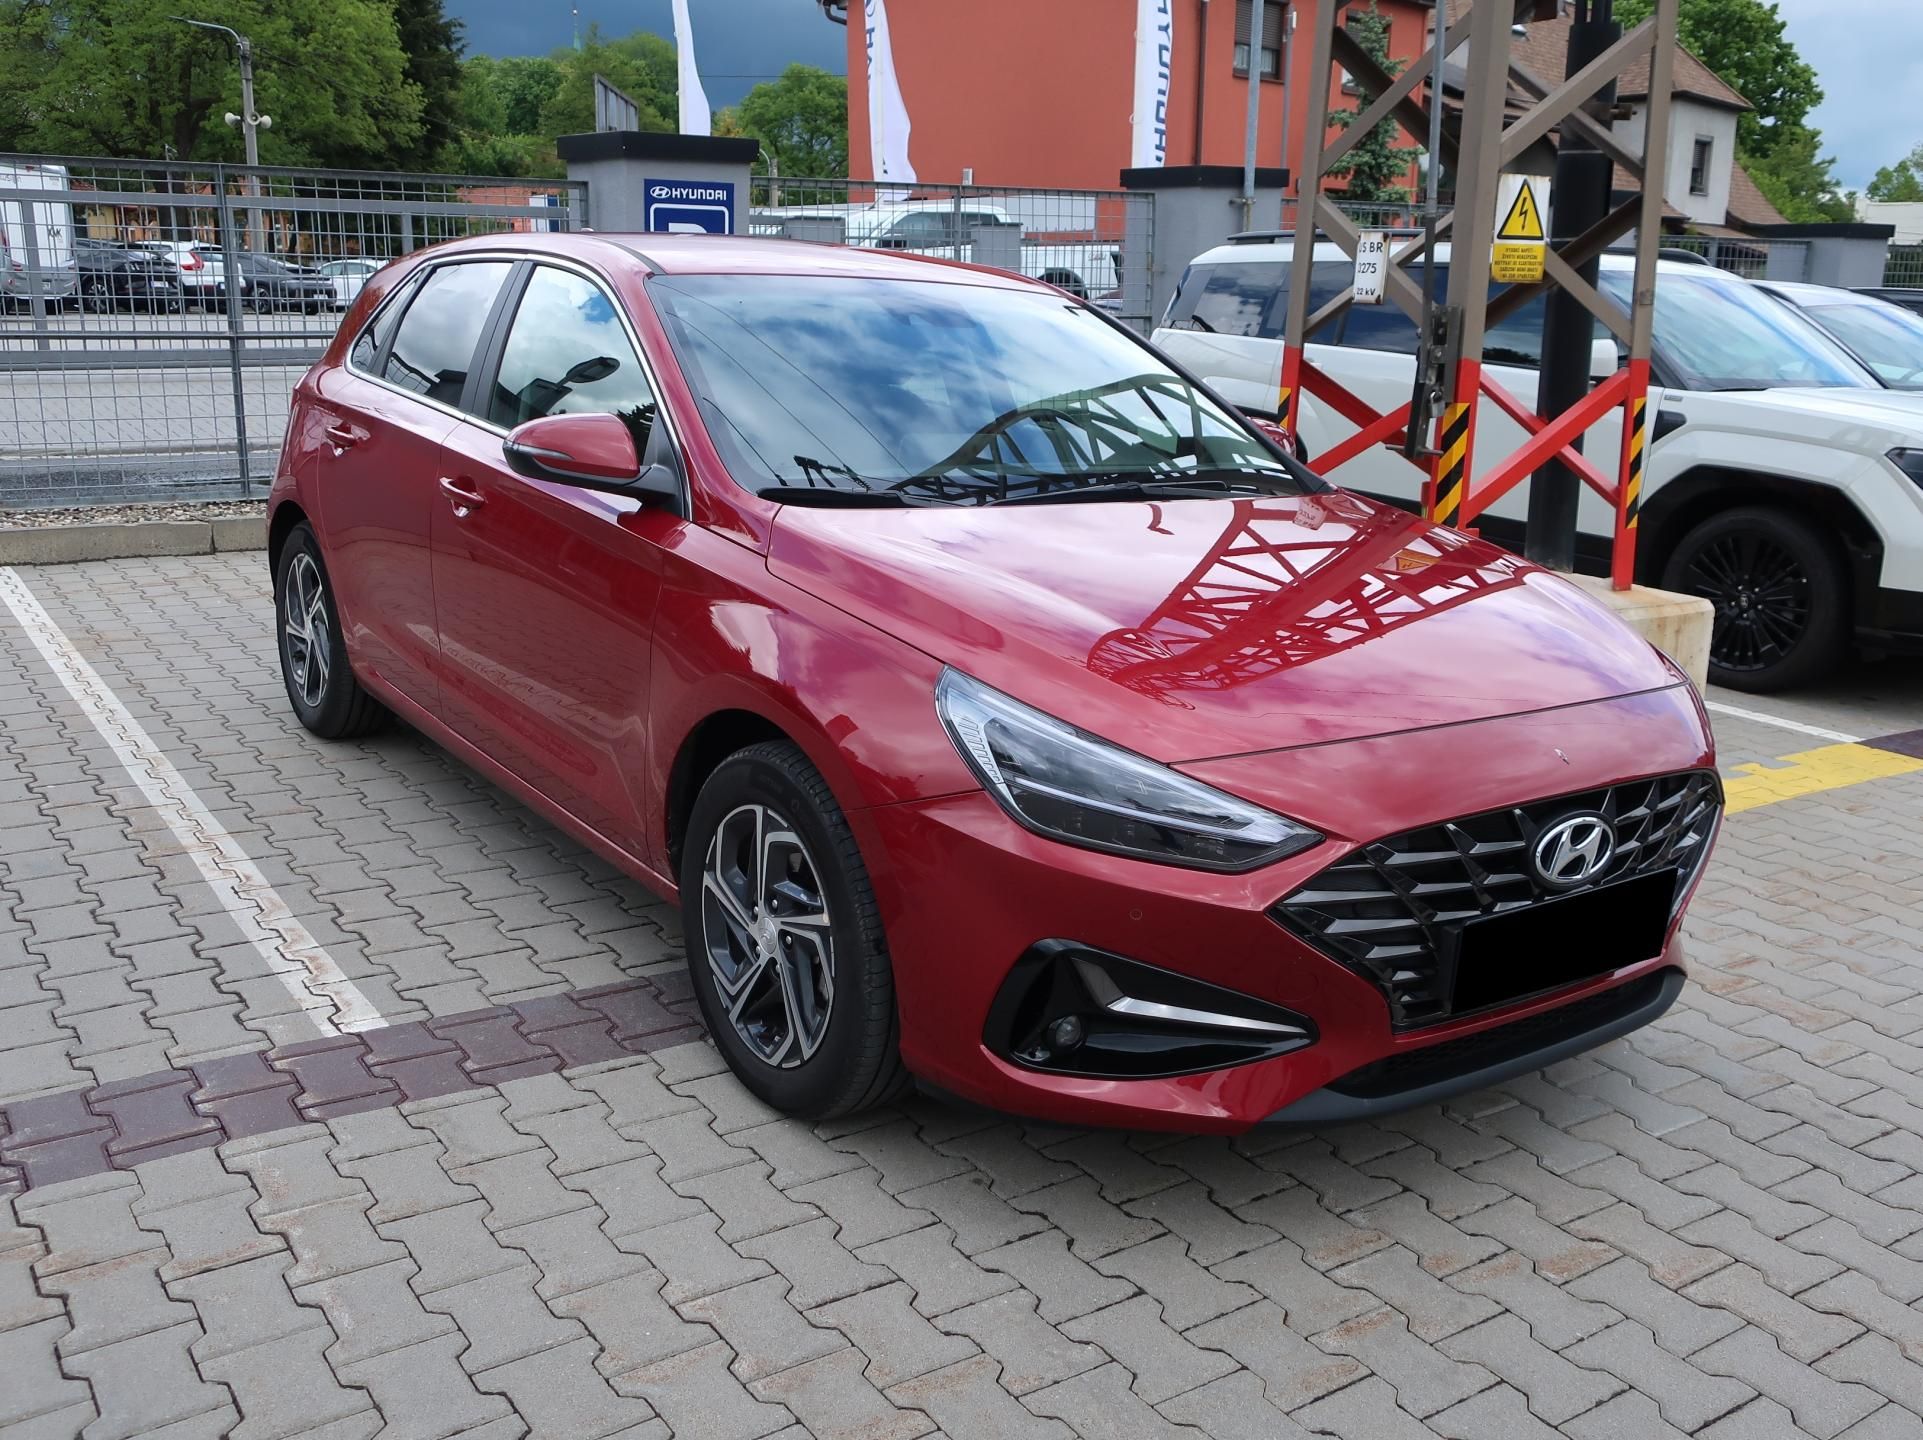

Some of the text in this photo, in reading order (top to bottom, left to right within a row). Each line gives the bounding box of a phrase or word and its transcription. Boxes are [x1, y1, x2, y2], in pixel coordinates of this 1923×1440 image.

[672, 187, 727, 201] HYUNDAI
[1369, 241, 1384, 253] BR
[1365, 287, 1376, 296] kV
